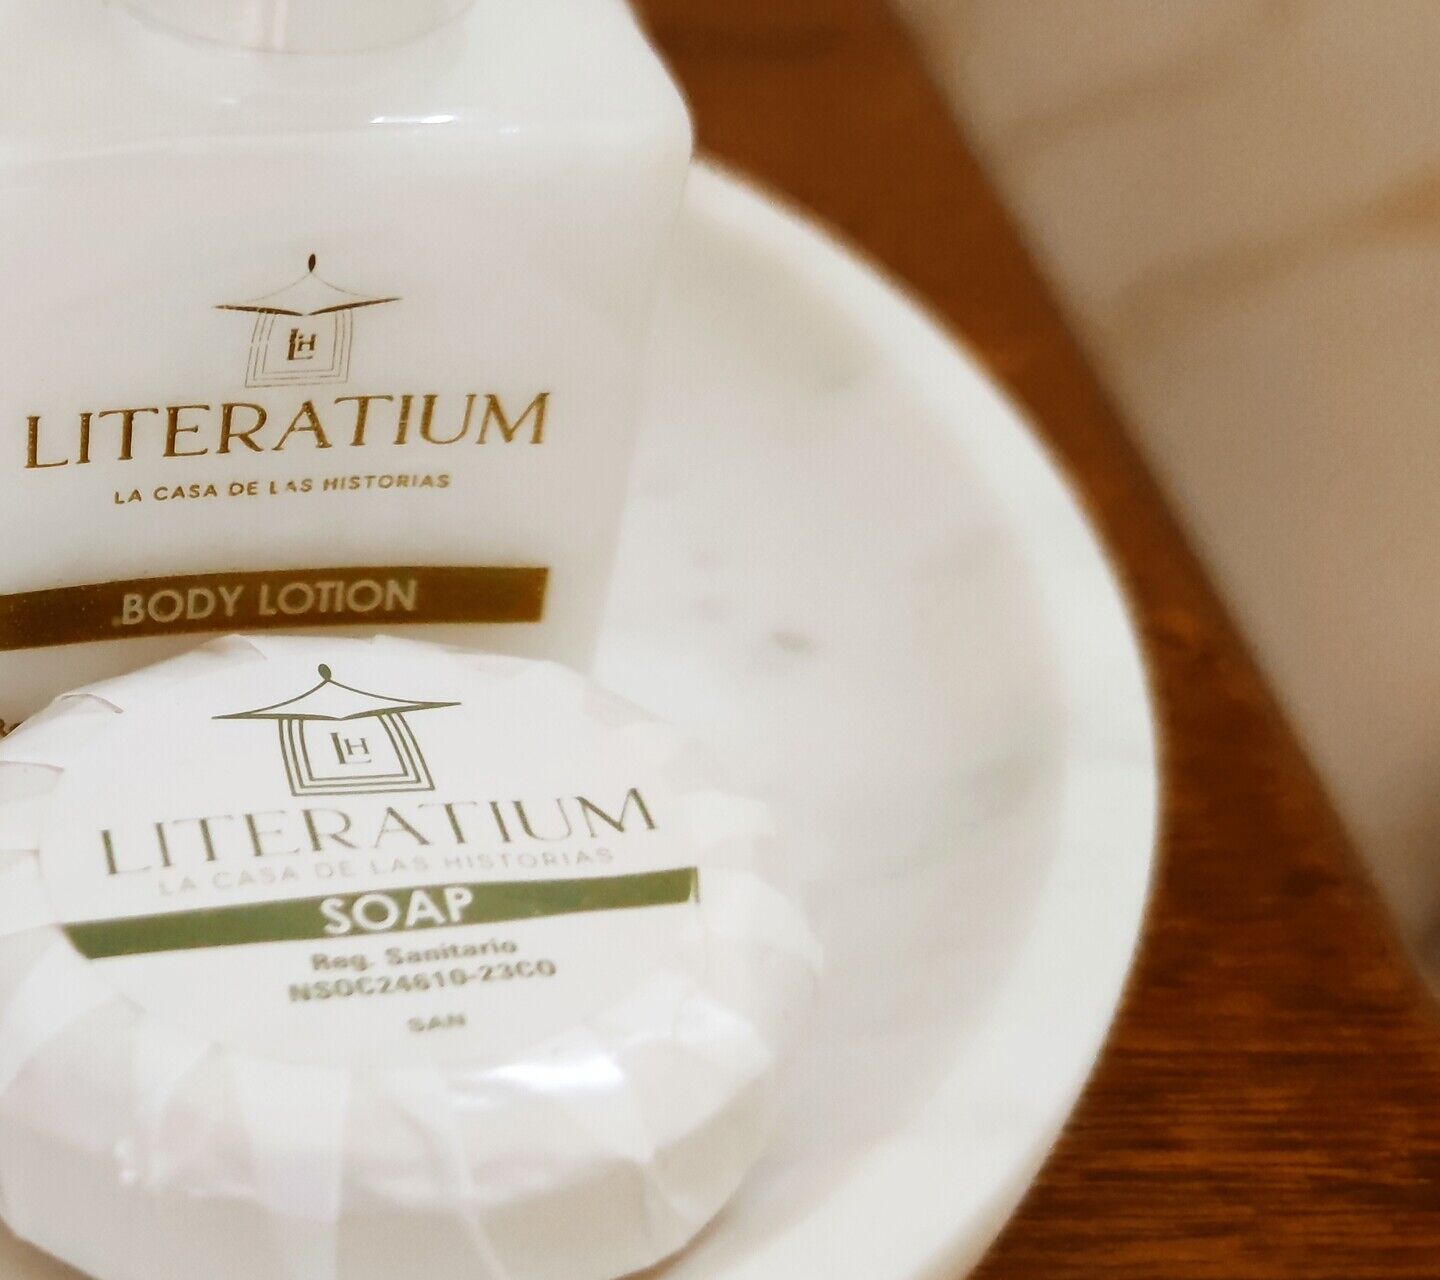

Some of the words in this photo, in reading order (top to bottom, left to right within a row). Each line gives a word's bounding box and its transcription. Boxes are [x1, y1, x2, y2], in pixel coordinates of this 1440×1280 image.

[24, 391, 551, 469] LITERATIUM
[114, 488, 143, 505] LA
[153, 483, 219, 502] CASA
[228, 480, 259, 497] DE
[269, 478, 313, 495] LAS
[323, 473, 451, 492] HISTORIAS
[121, 583, 245, 625] BODY
[259, 578, 418, 616] LOTION
[98, 786, 659, 878] LITERATIUM
[160, 877, 198, 897] LA
[212, 866, 301, 891] CASA
[315, 860, 353, 880] DE
[371, 854, 429, 875] LAS
[444, 847, 615, 871] HISTORIAS
[319, 886, 474, 936] SOAP
[312, 952, 374, 972] Reg.
[384, 938, 518, 966] Sanitario
[408, 1012, 466, 1033] SAN
